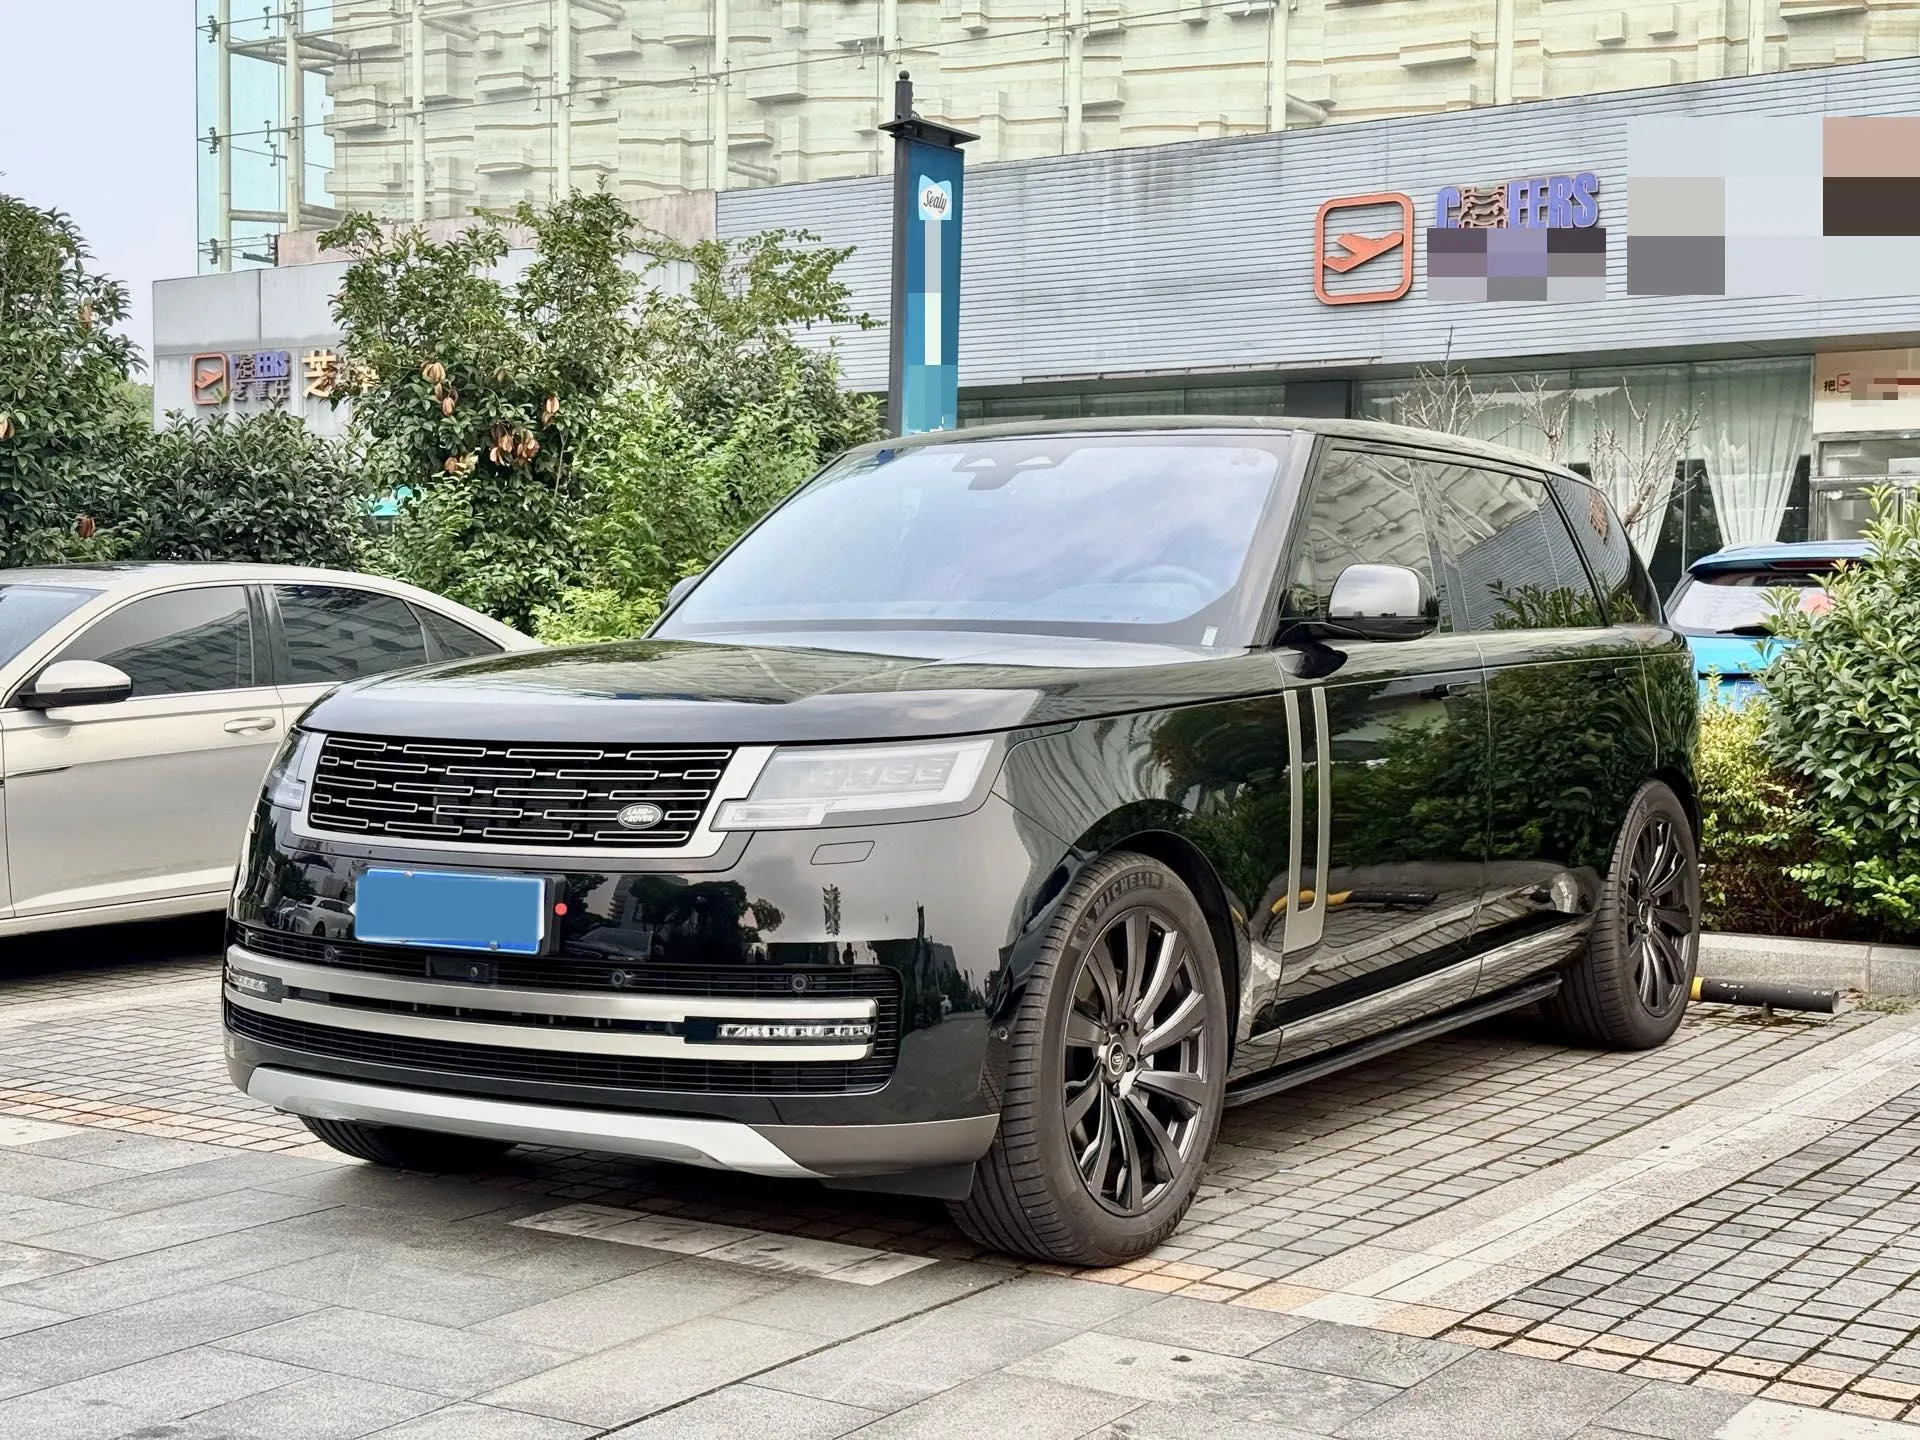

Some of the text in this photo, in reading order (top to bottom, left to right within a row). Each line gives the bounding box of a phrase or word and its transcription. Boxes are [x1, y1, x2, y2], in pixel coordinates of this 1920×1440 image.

[923, 190, 947, 213] Sealy
[626, 808, 649, 816] LAND
[627, 815, 654, 823] ROVER
